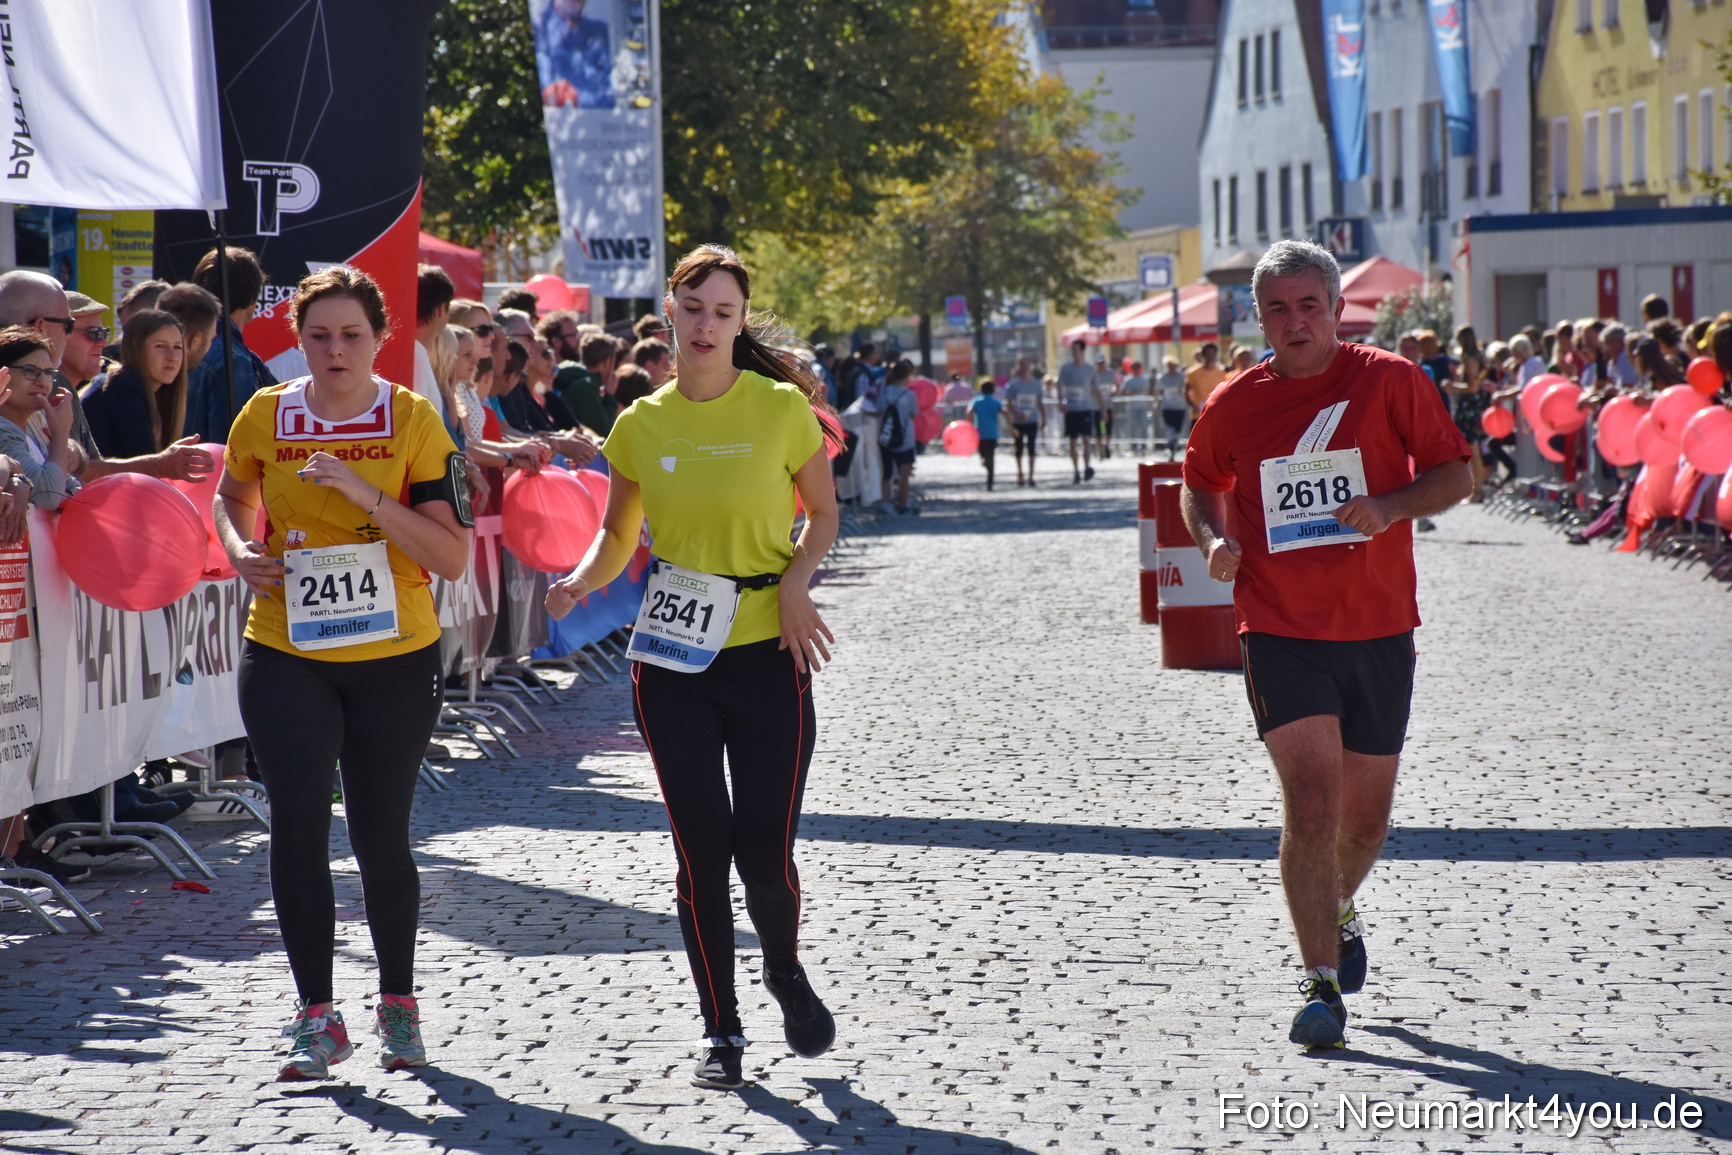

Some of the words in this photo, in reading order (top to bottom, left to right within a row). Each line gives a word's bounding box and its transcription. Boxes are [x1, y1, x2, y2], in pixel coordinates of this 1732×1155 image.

[249, 167, 271, 175] Team
[81, 228, 110, 251] 19.
[334, 444, 394, 462] BÖGL
[1288, 459, 1333, 474] BOCK
[1276, 475, 1352, 511] 2618
[1286, 512, 1308, 520] PARTL
[1297, 523, 1340, 537] Jürgen
[312, 553, 358, 567] BOCK
[300, 569, 377, 606] 2414
[668, 573, 709, 593] BOCK
[310, 609, 332, 617] PARTL
[333, 606, 365, 615] Neumarkt
[648, 590, 714, 633] 2541
[317, 620, 370, 637] Jennifer
[665, 629, 694, 641] Neumarkt
[648, 638, 689, 661] Marina
